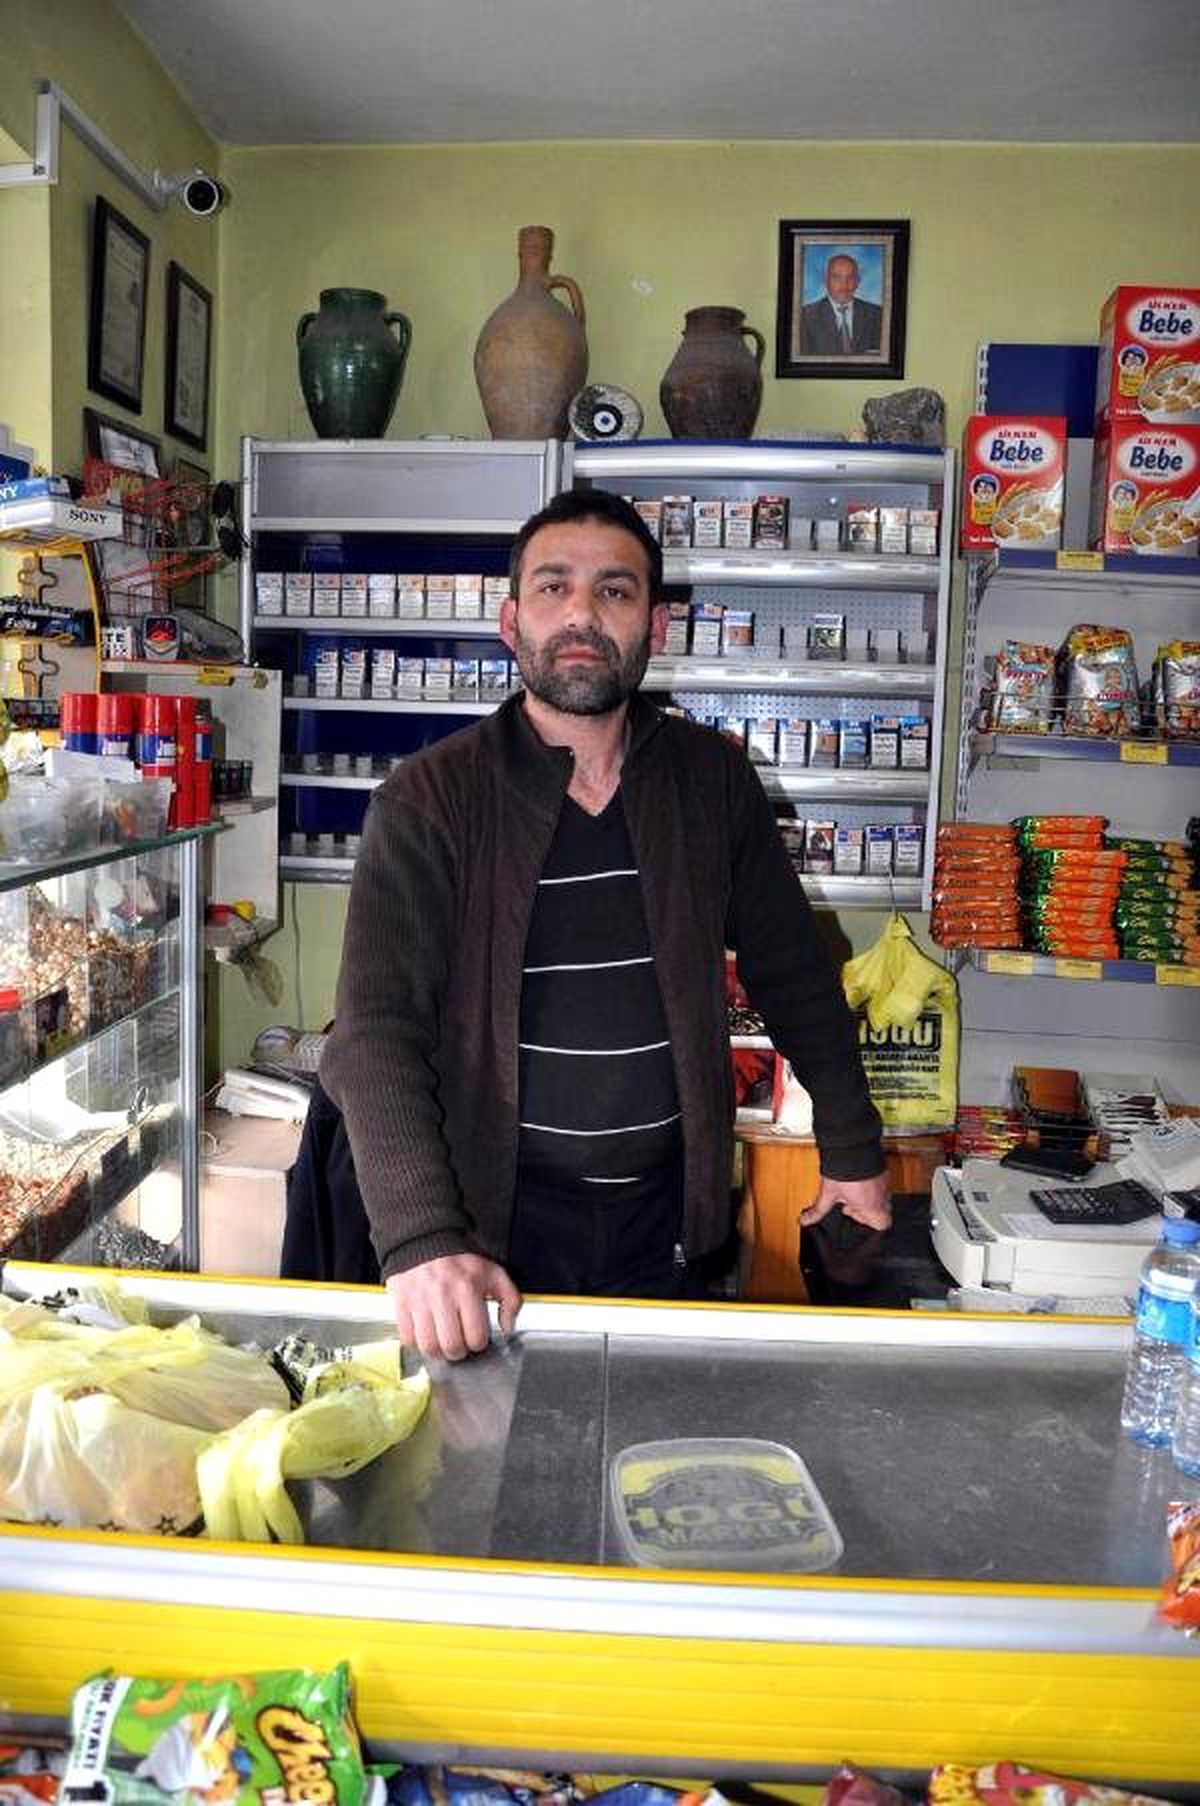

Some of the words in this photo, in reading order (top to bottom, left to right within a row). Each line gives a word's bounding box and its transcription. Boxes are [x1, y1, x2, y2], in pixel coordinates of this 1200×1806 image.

[1138, 309, 1193, 335] Bebe
[989, 439, 1043, 462] Bebe
[1129, 446, 1184, 472] Bebe
[68, 508, 107, 525] SONY
